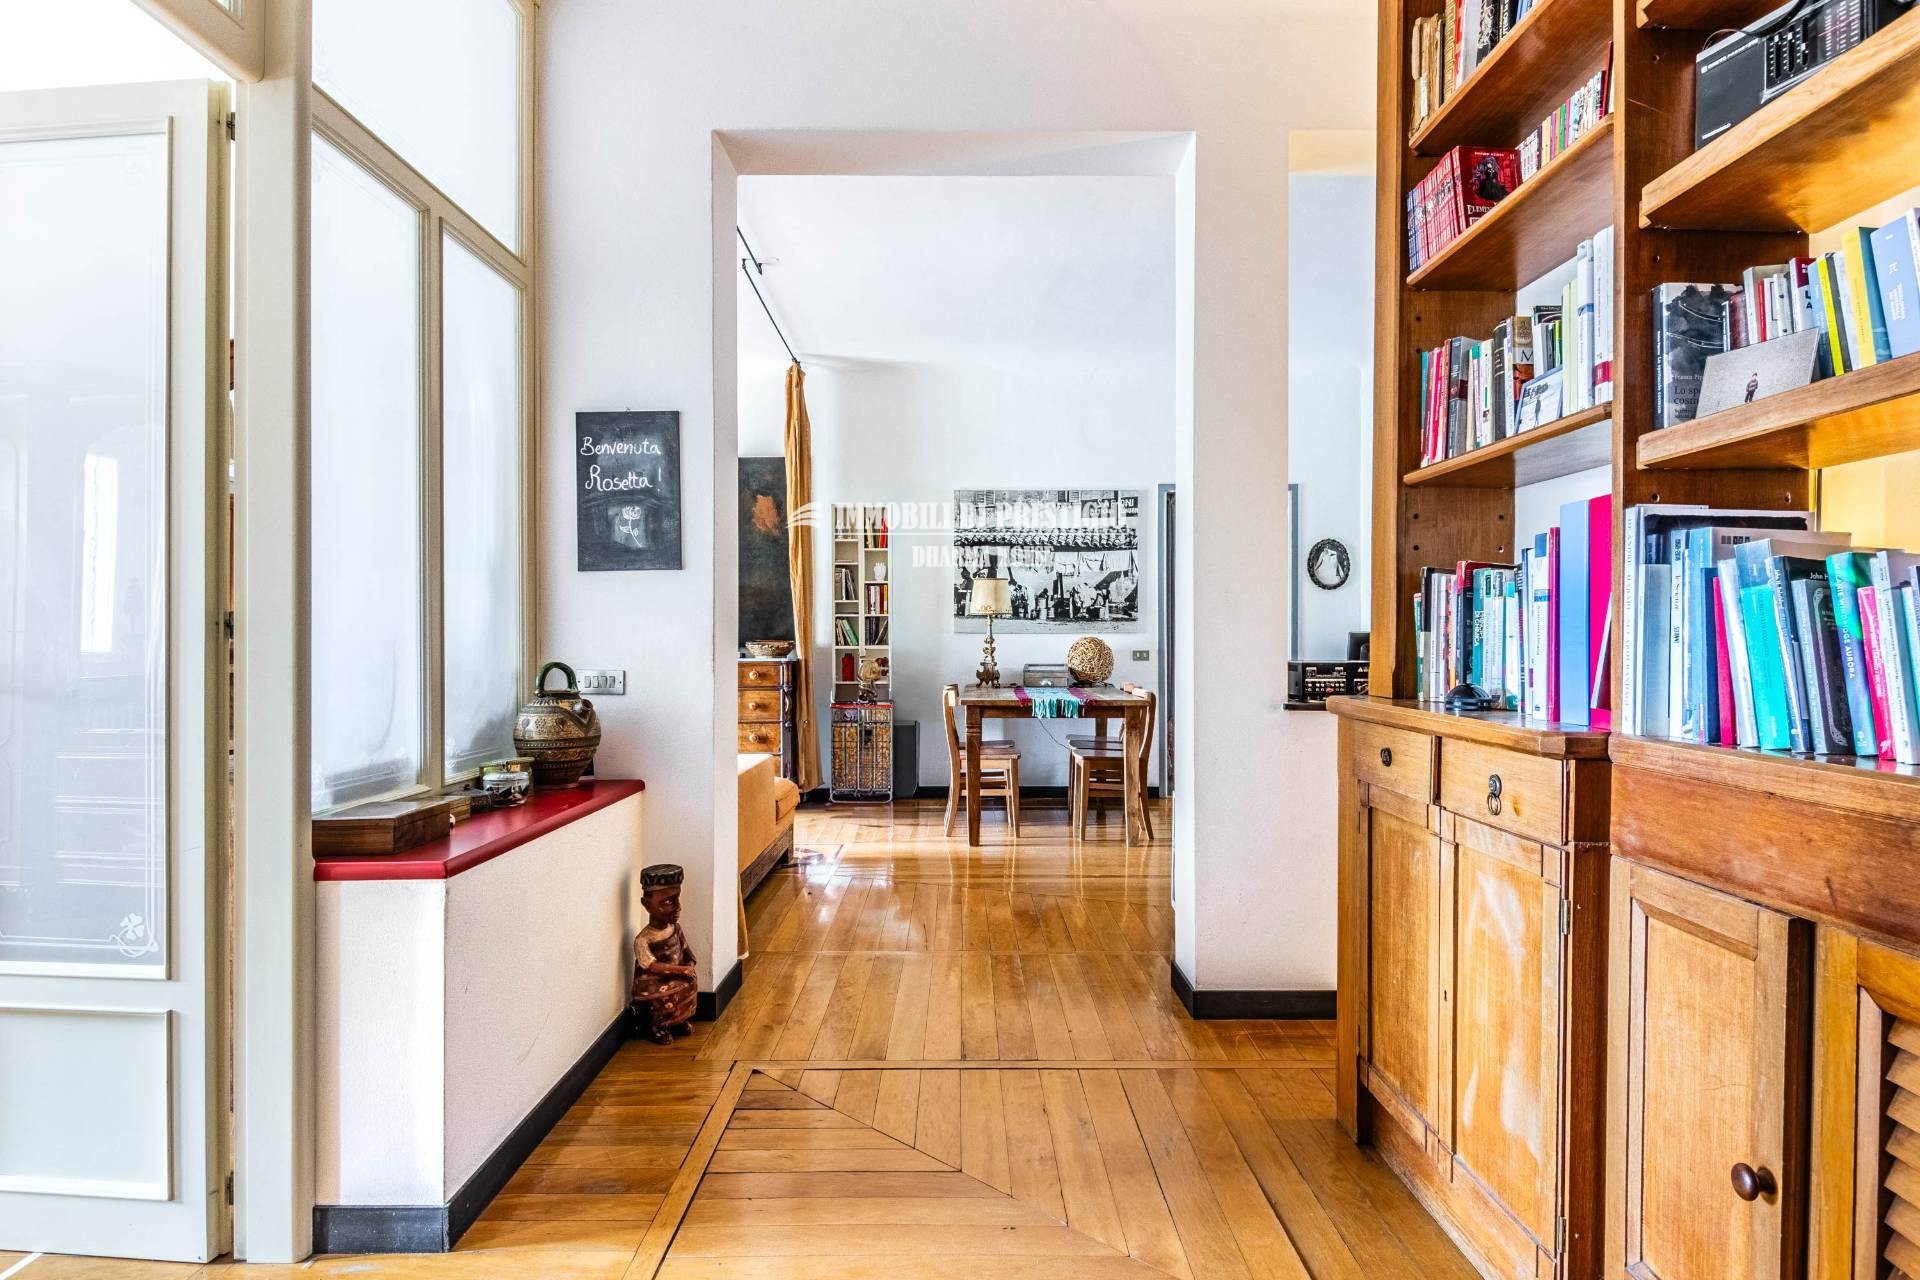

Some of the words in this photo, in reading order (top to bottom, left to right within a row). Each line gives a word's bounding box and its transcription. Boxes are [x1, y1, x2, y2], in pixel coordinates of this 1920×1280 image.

[580, 436, 662, 456] Benvenuta
[1810, 571, 1824, 579] John
[1844, 646, 1856, 680] AURORA
